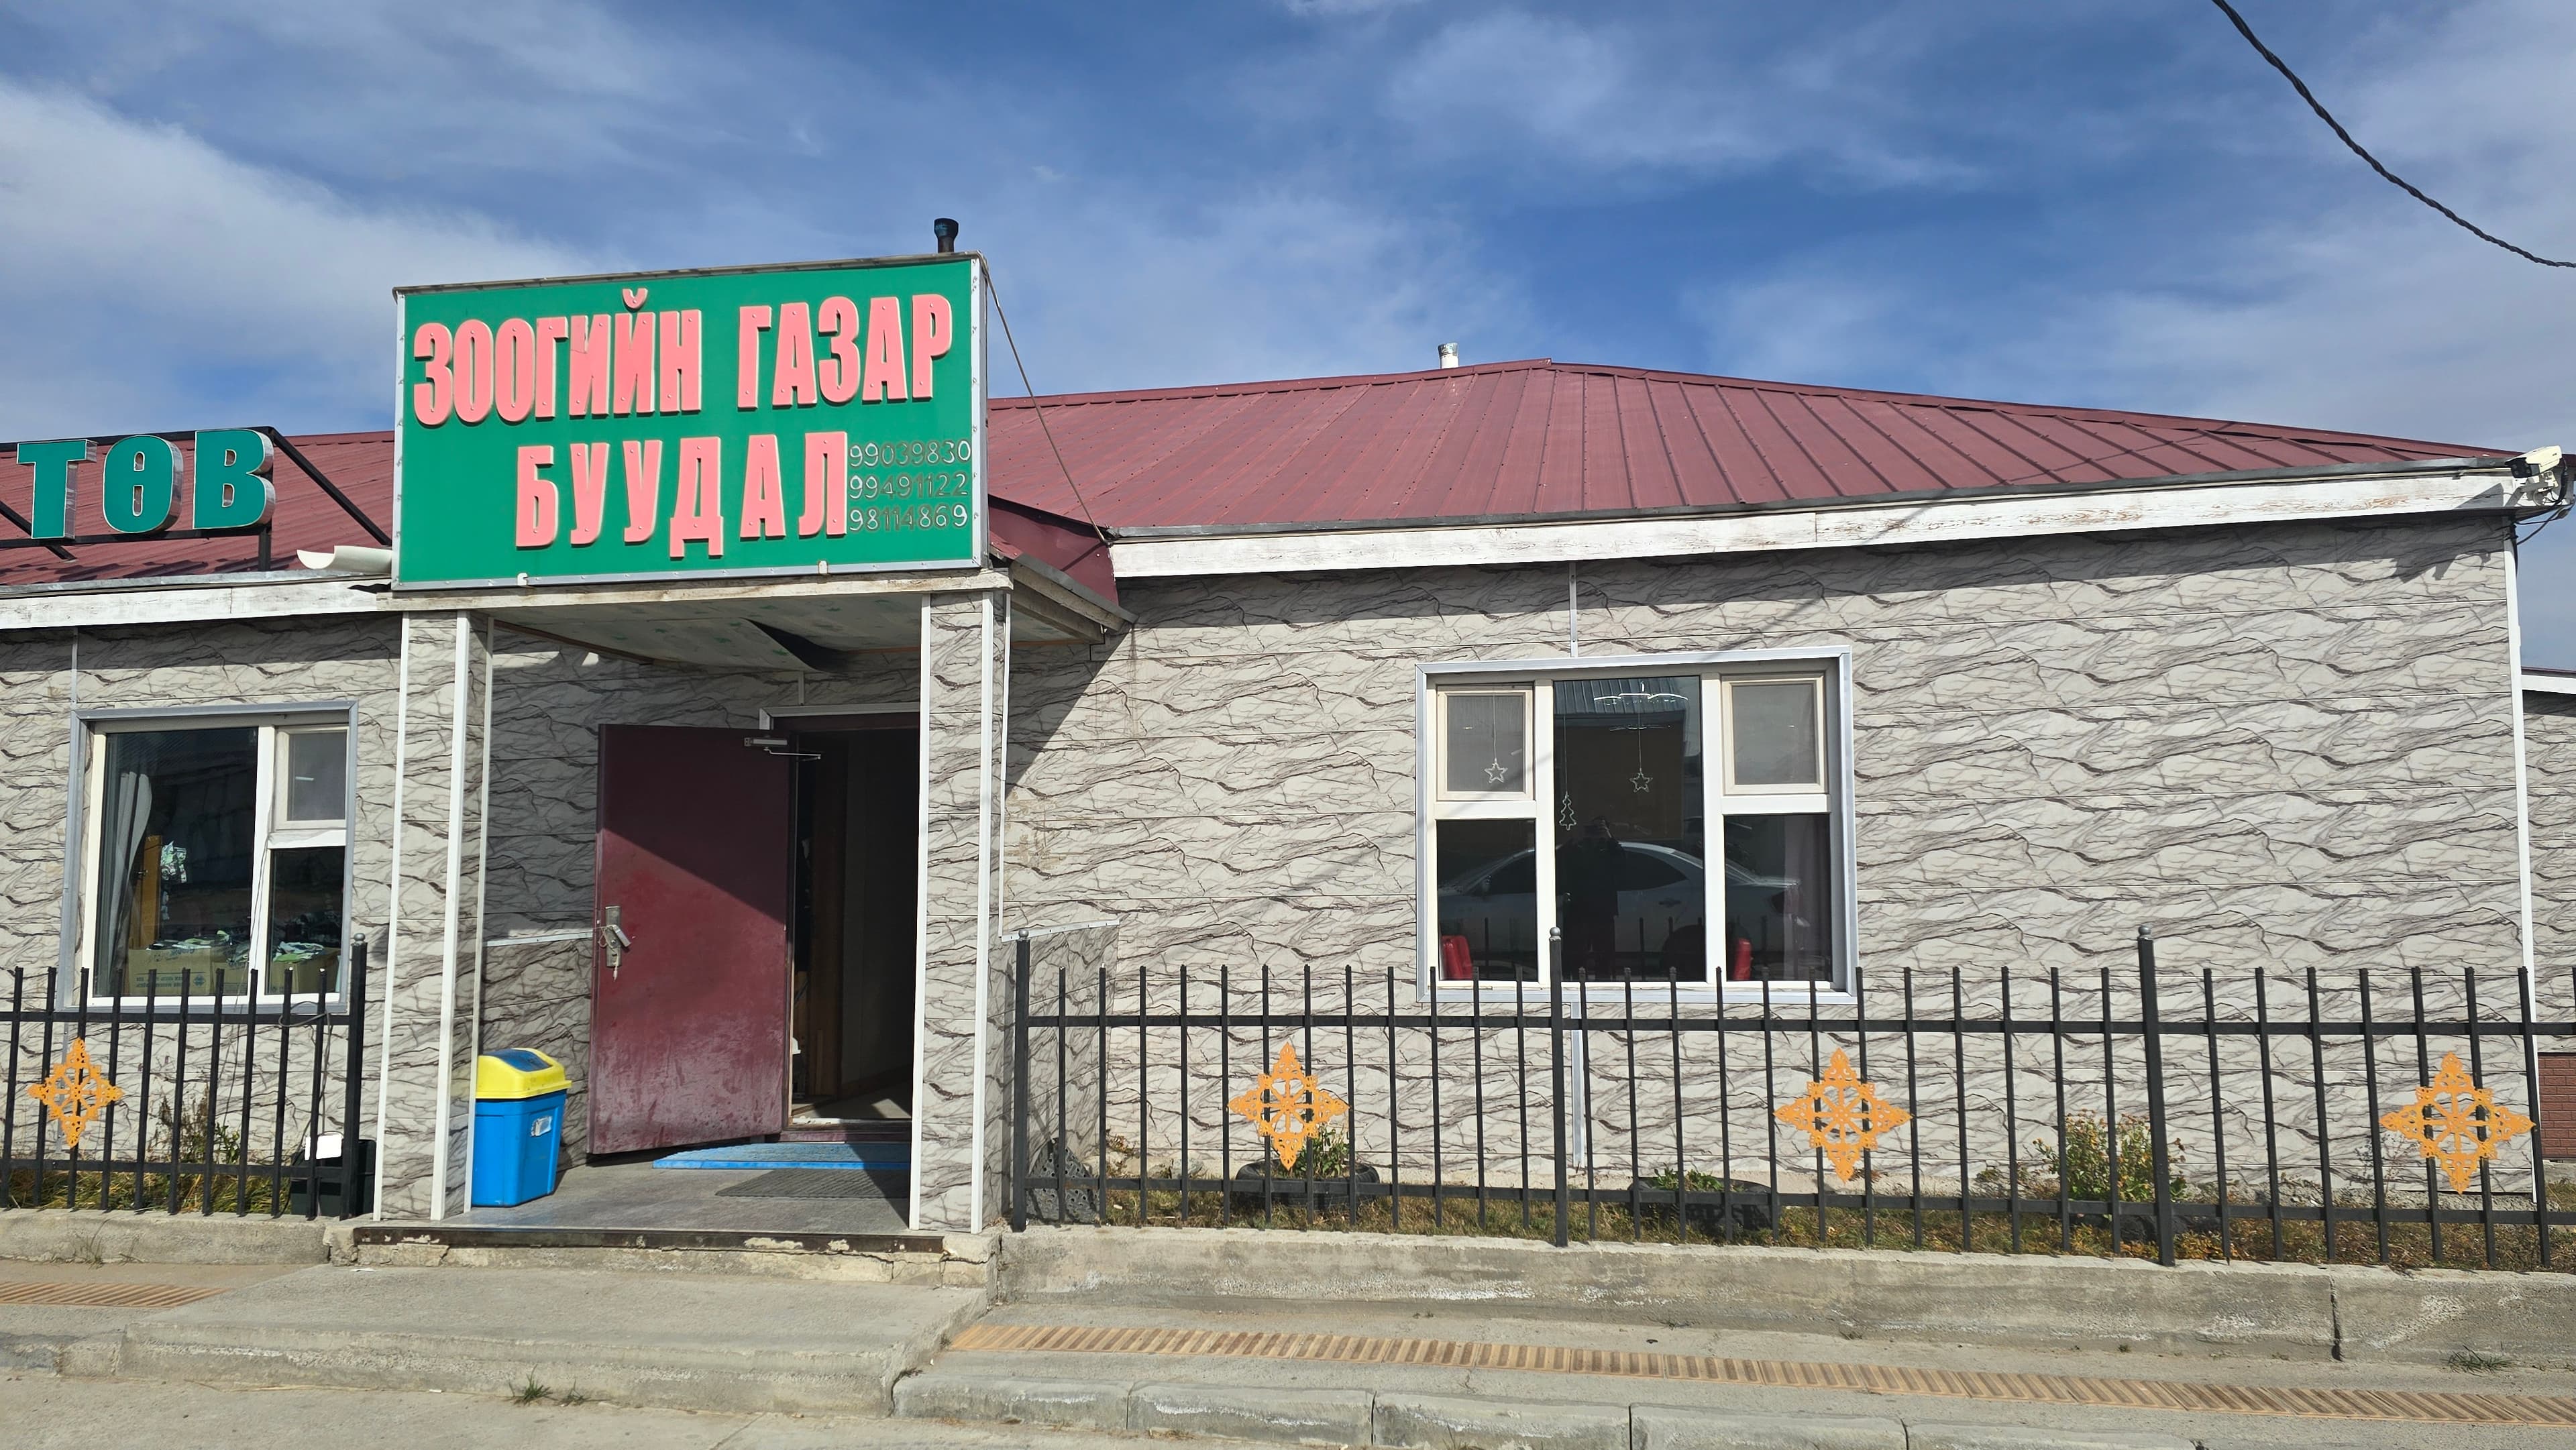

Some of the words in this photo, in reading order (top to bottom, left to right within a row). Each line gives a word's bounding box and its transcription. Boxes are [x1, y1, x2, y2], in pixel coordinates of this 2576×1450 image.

[413, 287, 702, 427] ЗООГИЙН
[738, 293, 953, 410] ГАЗАР
[16, 429, 275, 539] ТӨВ
[849, 439, 971, 467] 99039830
[849, 472, 969, 499] 99491122
[515, 431, 848, 558] БУУДАЛ
[849, 504, 968, 531] 98114869
